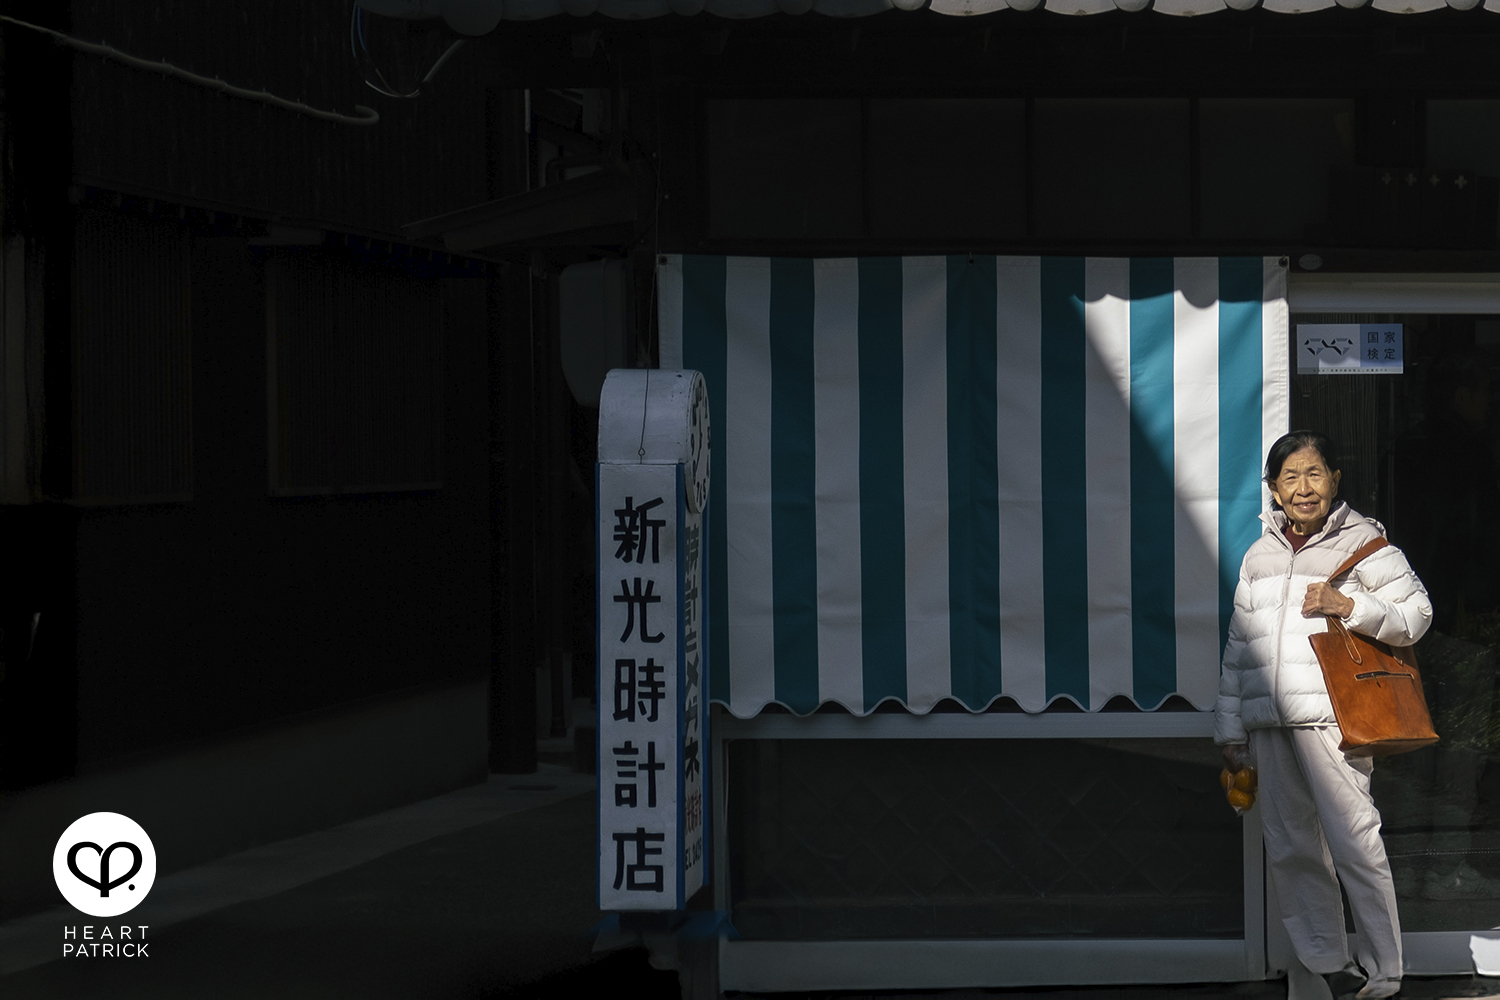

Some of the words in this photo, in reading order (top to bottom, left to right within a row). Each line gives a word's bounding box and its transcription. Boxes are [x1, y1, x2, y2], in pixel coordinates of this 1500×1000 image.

[1367, 331, 1396, 343] 国家
[1367, 347, 1396, 360] 検定
[613, 495, 667, 894] 新光時計店
